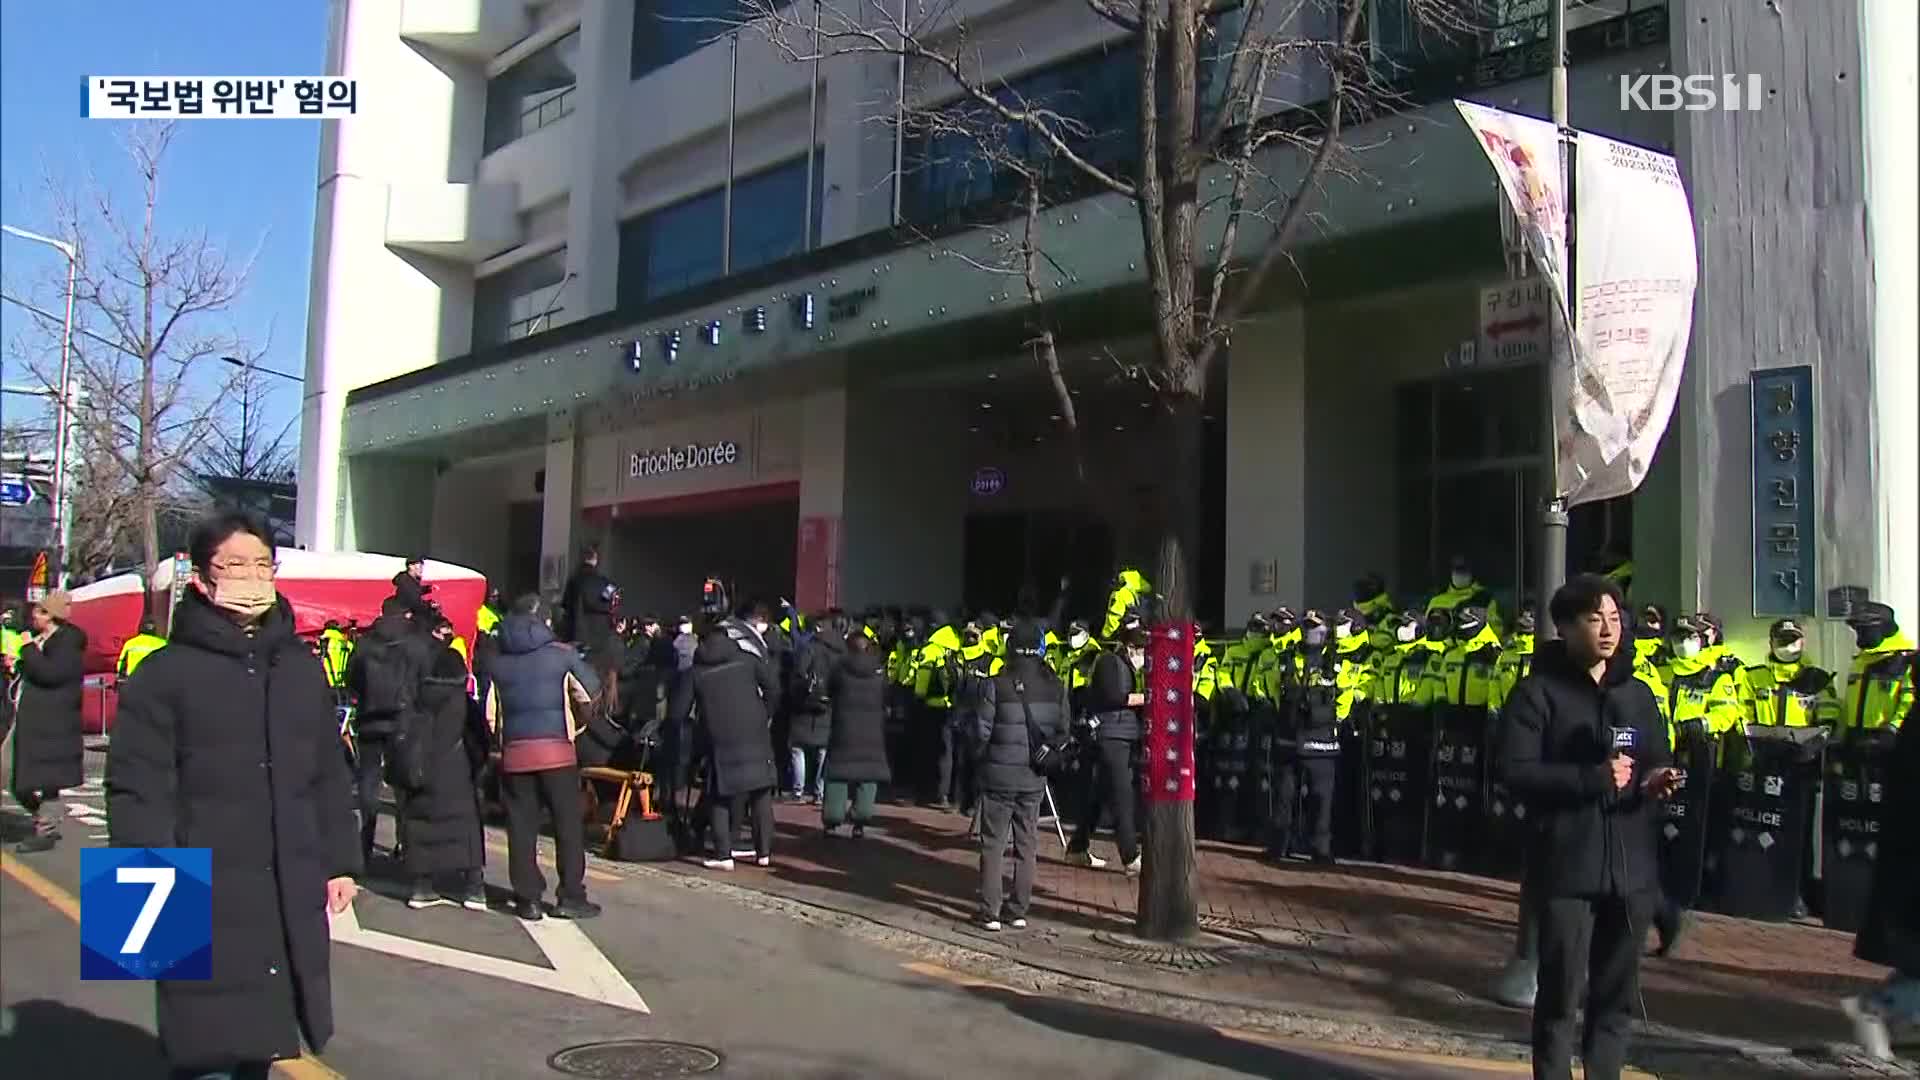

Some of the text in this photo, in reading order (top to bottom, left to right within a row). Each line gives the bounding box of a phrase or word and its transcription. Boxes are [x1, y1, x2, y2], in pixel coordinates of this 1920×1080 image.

[630, 440, 736, 477] Brioche Dorée
[1734, 806, 1783, 827] POLICE
